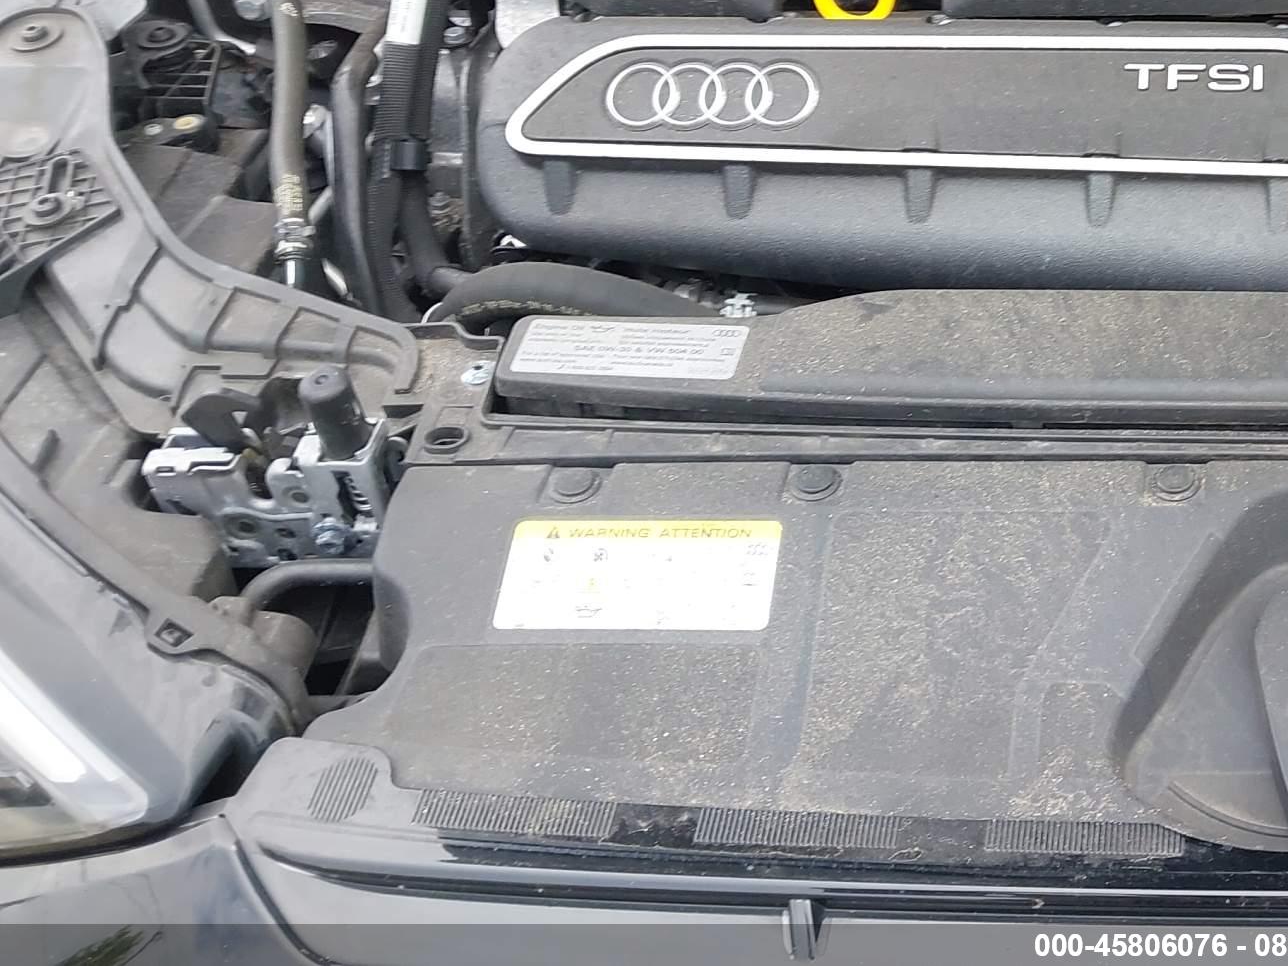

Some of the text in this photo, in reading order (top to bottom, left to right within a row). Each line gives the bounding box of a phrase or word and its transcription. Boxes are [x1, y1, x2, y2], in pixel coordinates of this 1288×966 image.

[1123, 63, 1265, 92] TFSI
[569, 527, 753, 538] WARNING ATTENTION
